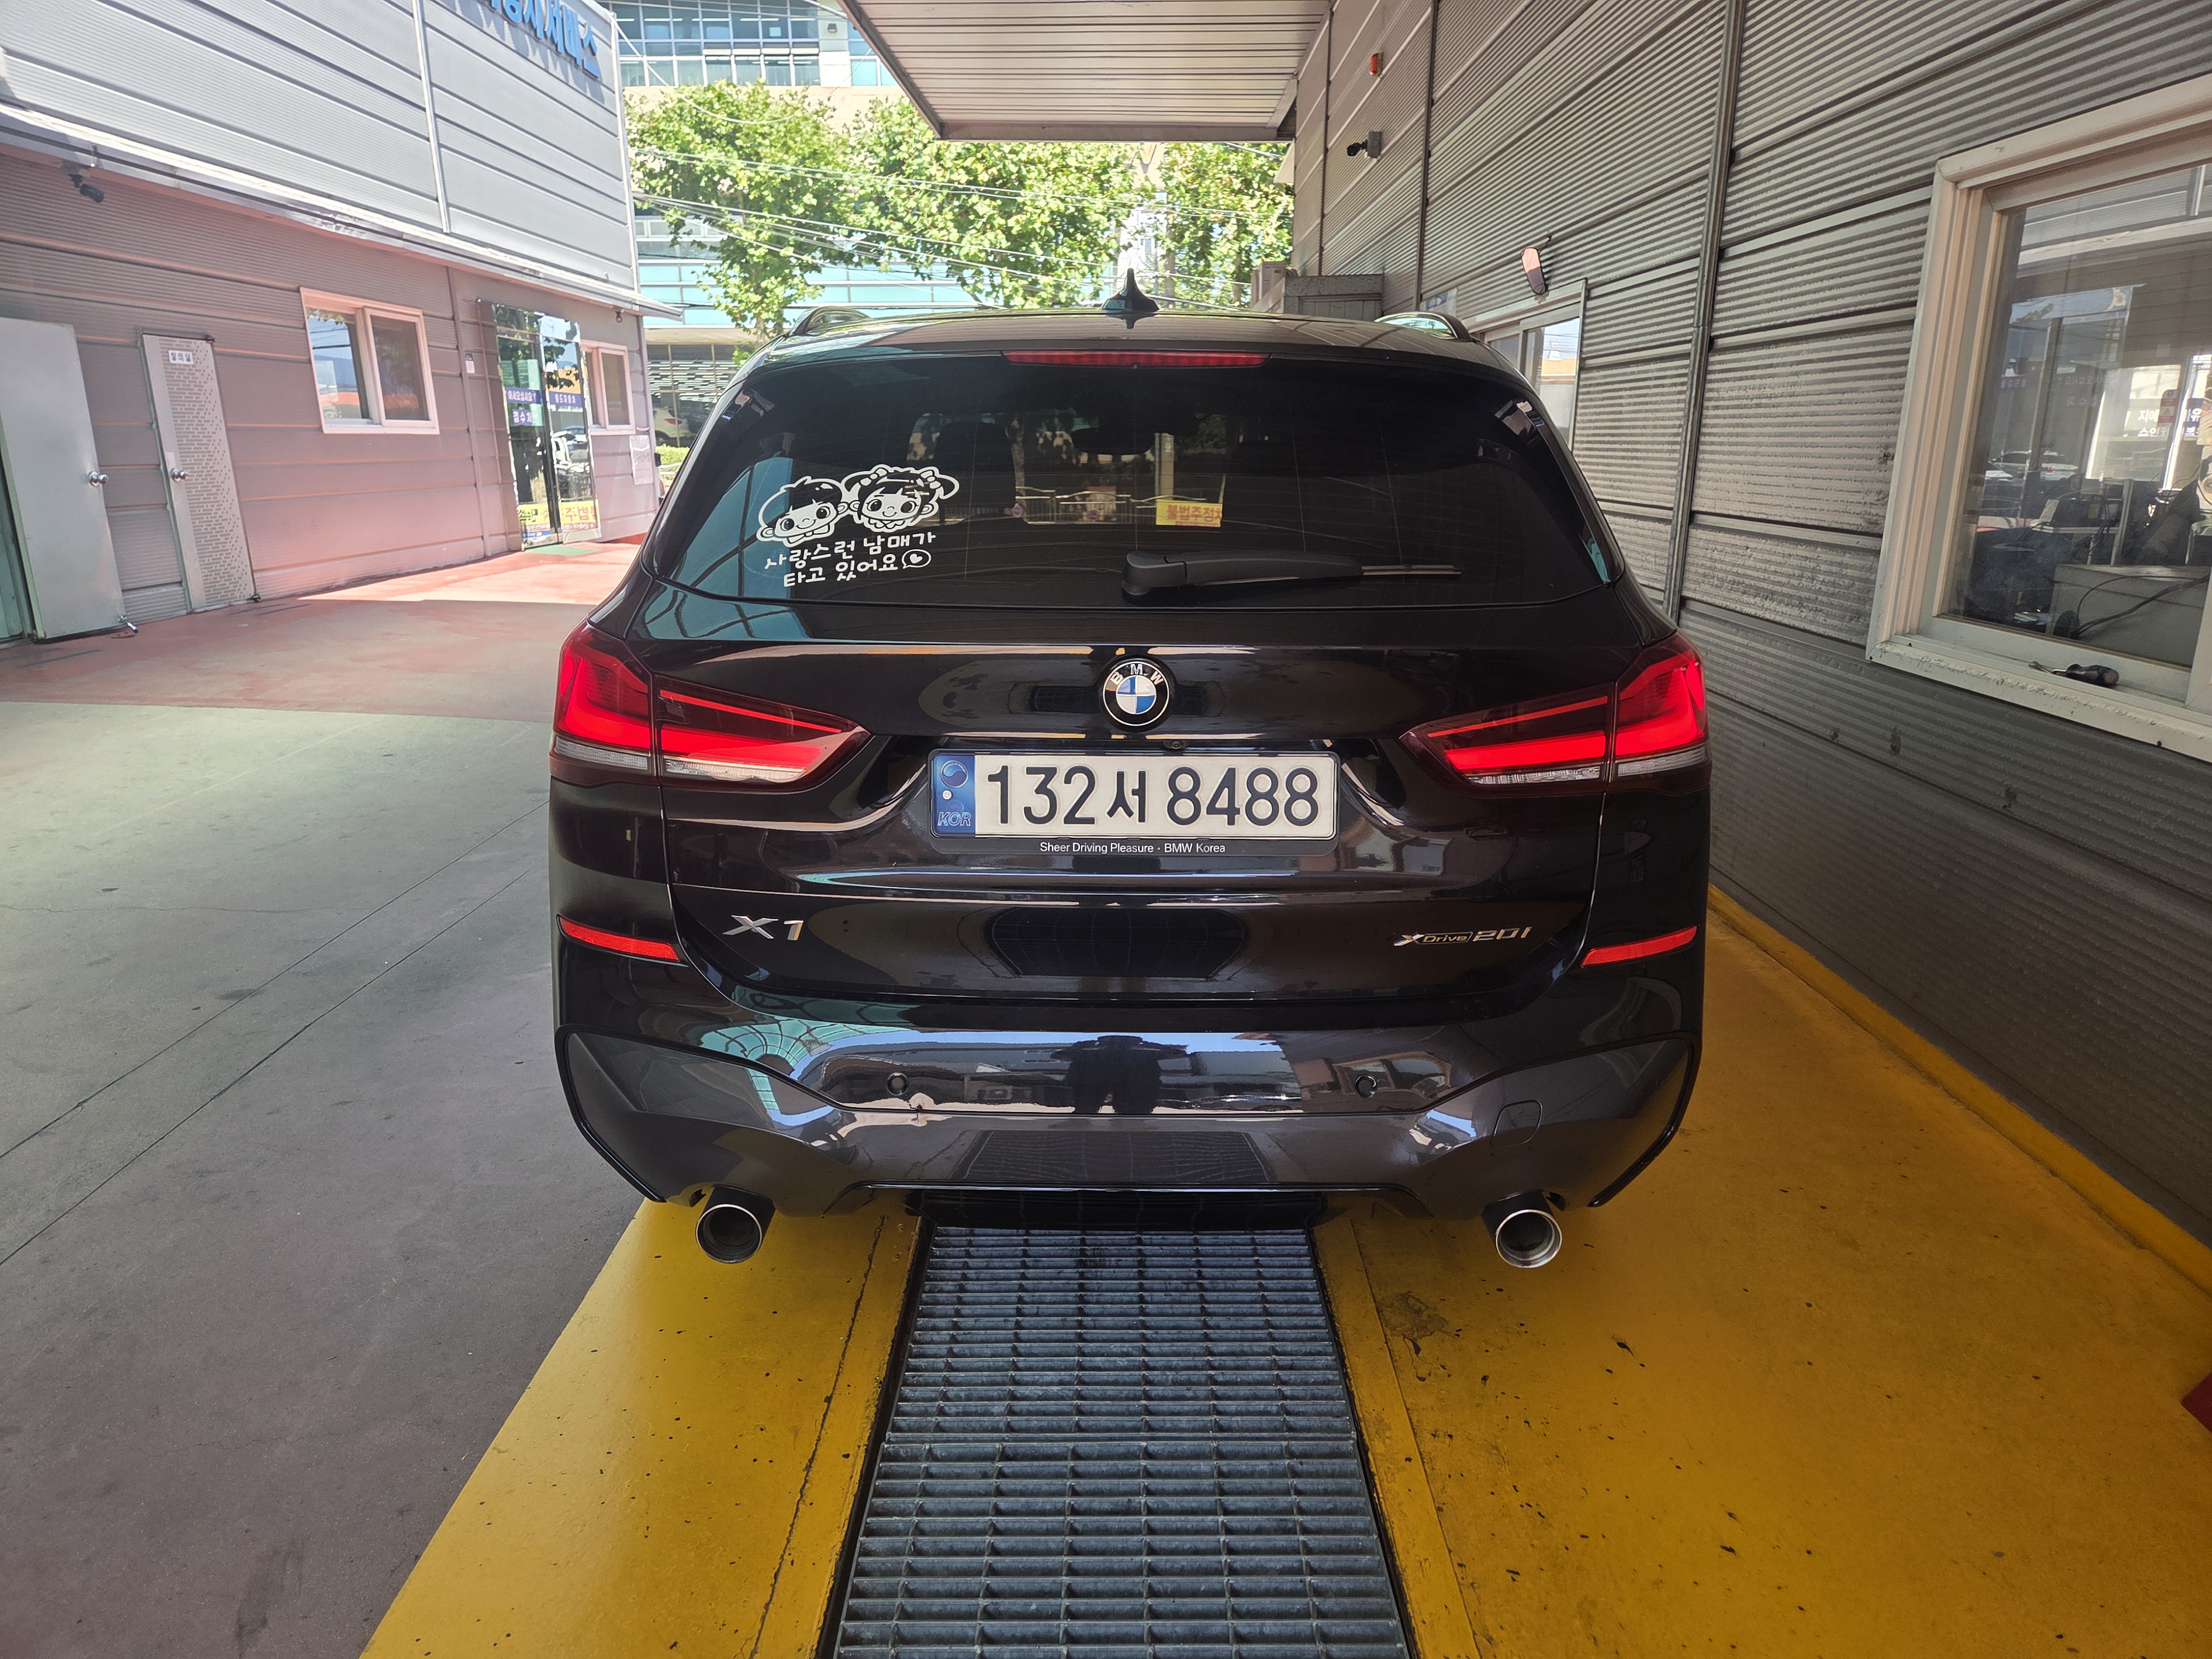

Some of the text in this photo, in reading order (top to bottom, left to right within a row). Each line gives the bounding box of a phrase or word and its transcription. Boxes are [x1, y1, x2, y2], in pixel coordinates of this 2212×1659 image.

[764, 532, 936, 569] 사랑스런 남매가
[784, 554, 899, 587] 타고 있어요
[1110, 664, 1164, 685] BMW
[988, 765, 1319, 826] 132서 8488
[937, 812, 972, 826] KOR
[1040, 842, 1226, 854] Sheer Driving Pleasure BMW Korea
[722, 915, 804, 941] X1
